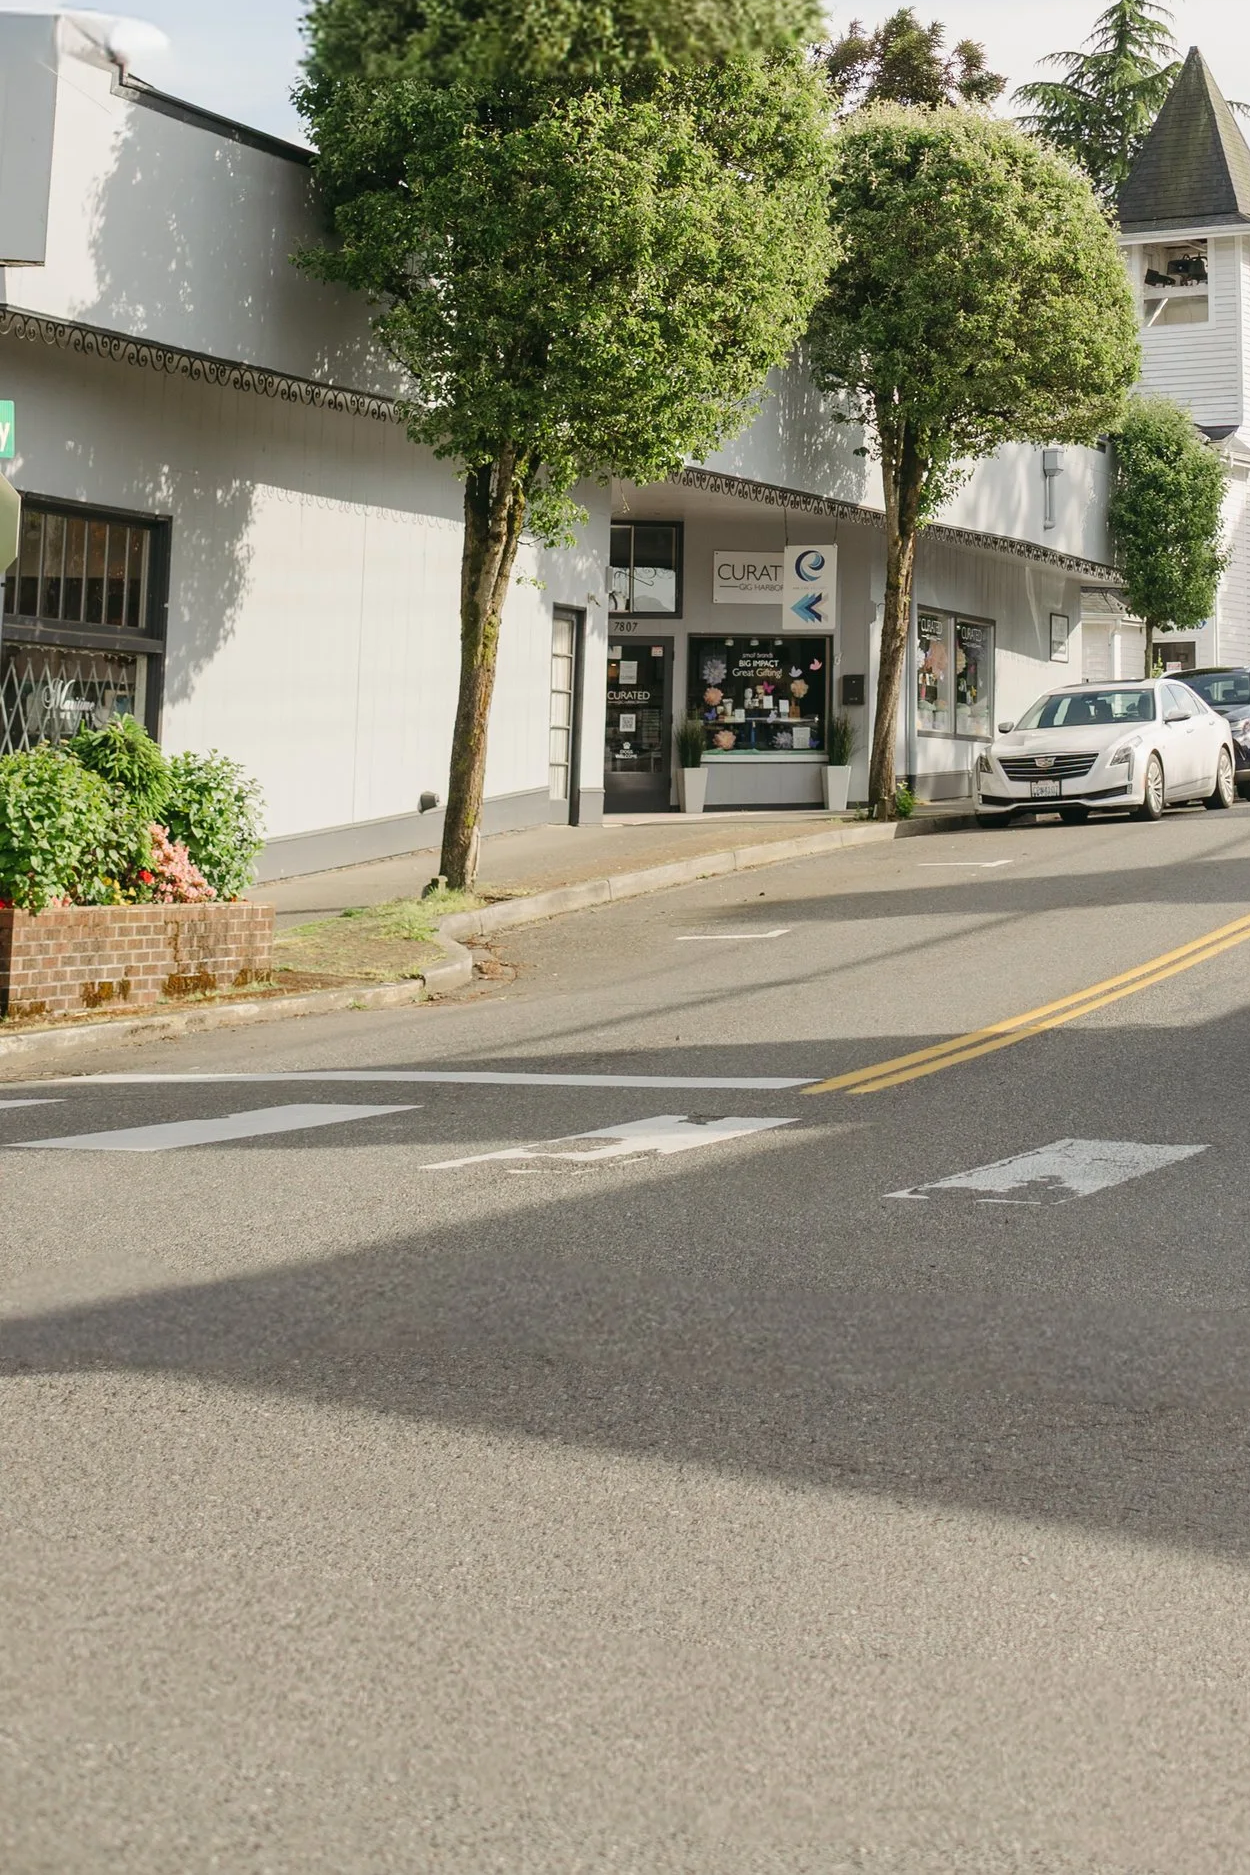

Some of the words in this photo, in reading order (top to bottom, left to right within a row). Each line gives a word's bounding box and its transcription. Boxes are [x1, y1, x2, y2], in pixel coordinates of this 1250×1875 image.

[738, 584, 753, 592] GIG
[613, 622, 638, 632] 7807
[752, 660, 779, 668] IMPACT
[732, 668, 754, 677] Great
[42, 678, 95, 711] Maritime
[607, 691, 650, 700] CURATED
